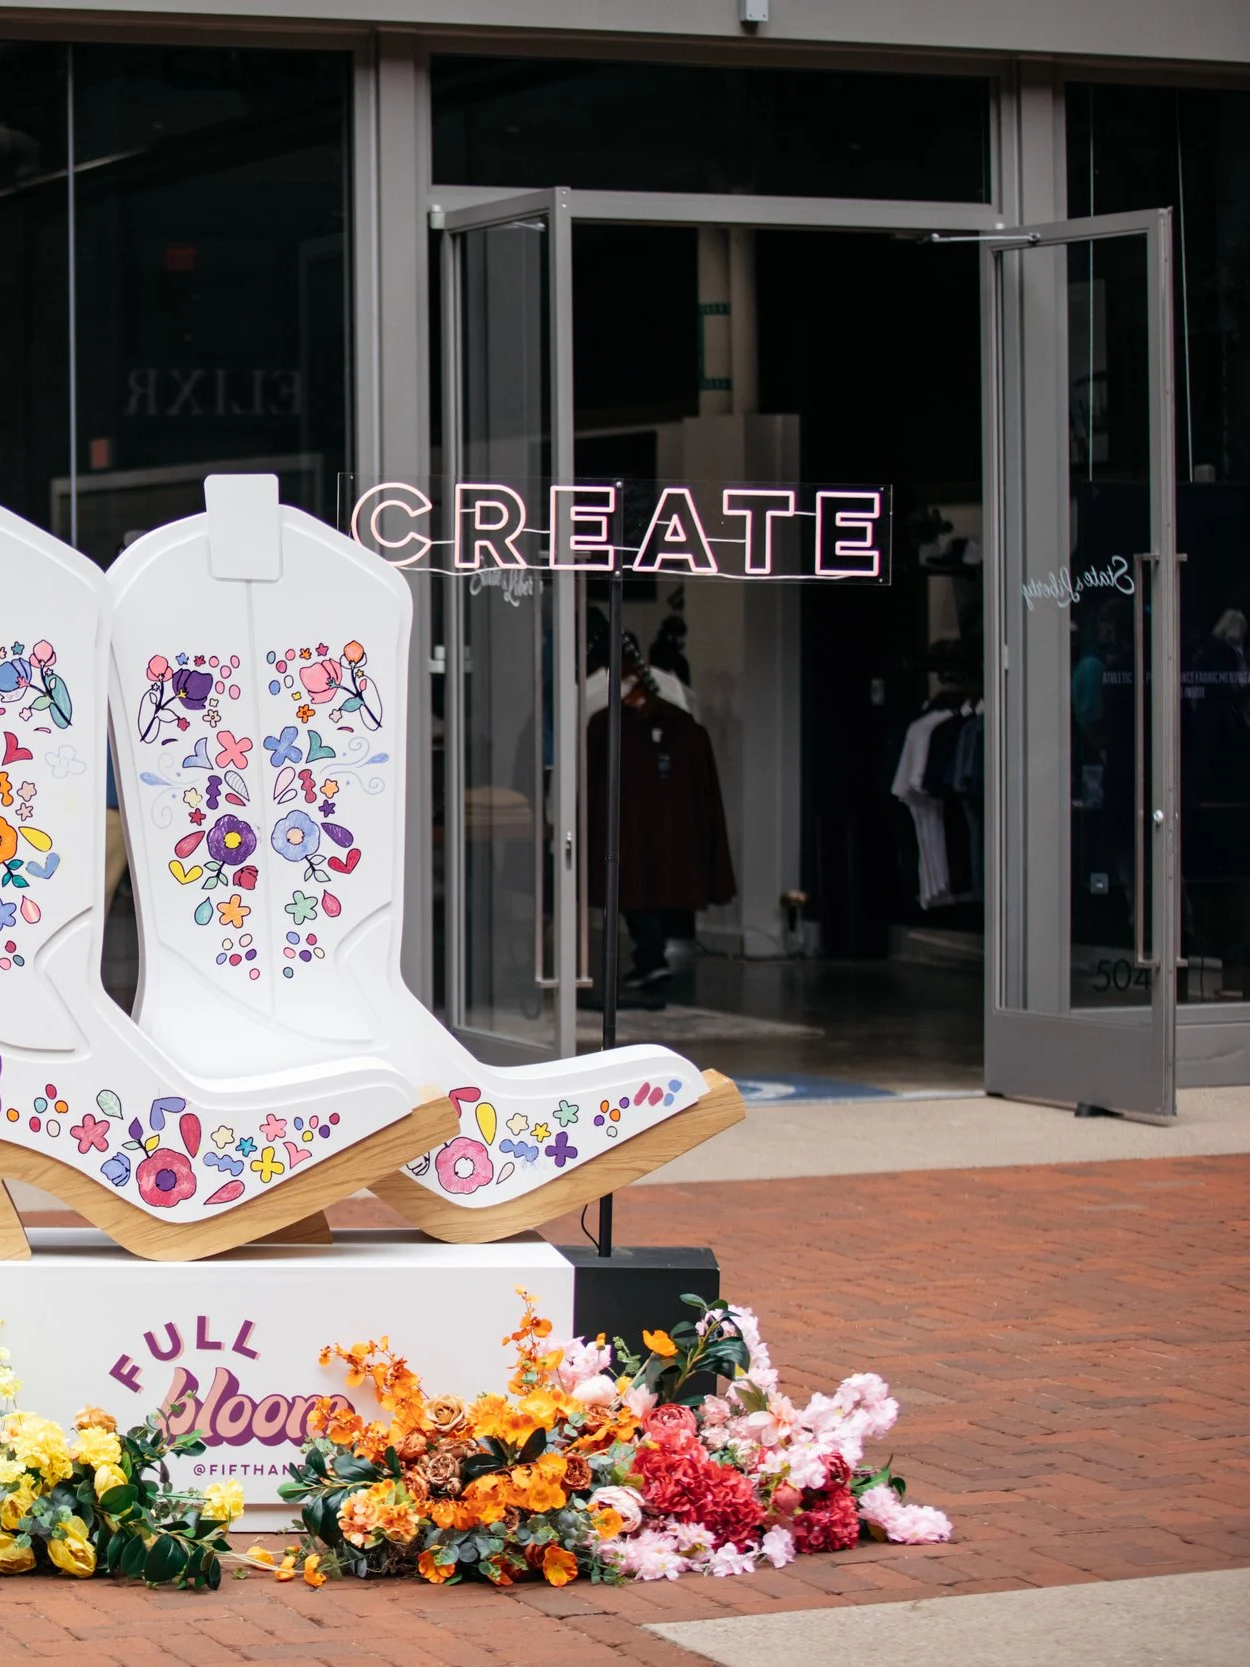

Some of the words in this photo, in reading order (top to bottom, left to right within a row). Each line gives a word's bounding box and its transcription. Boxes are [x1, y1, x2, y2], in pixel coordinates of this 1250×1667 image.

[350, 481, 881, 578] CREATE
[1093, 958, 1152, 991] 504
[109, 1315, 261, 1394] FULL
